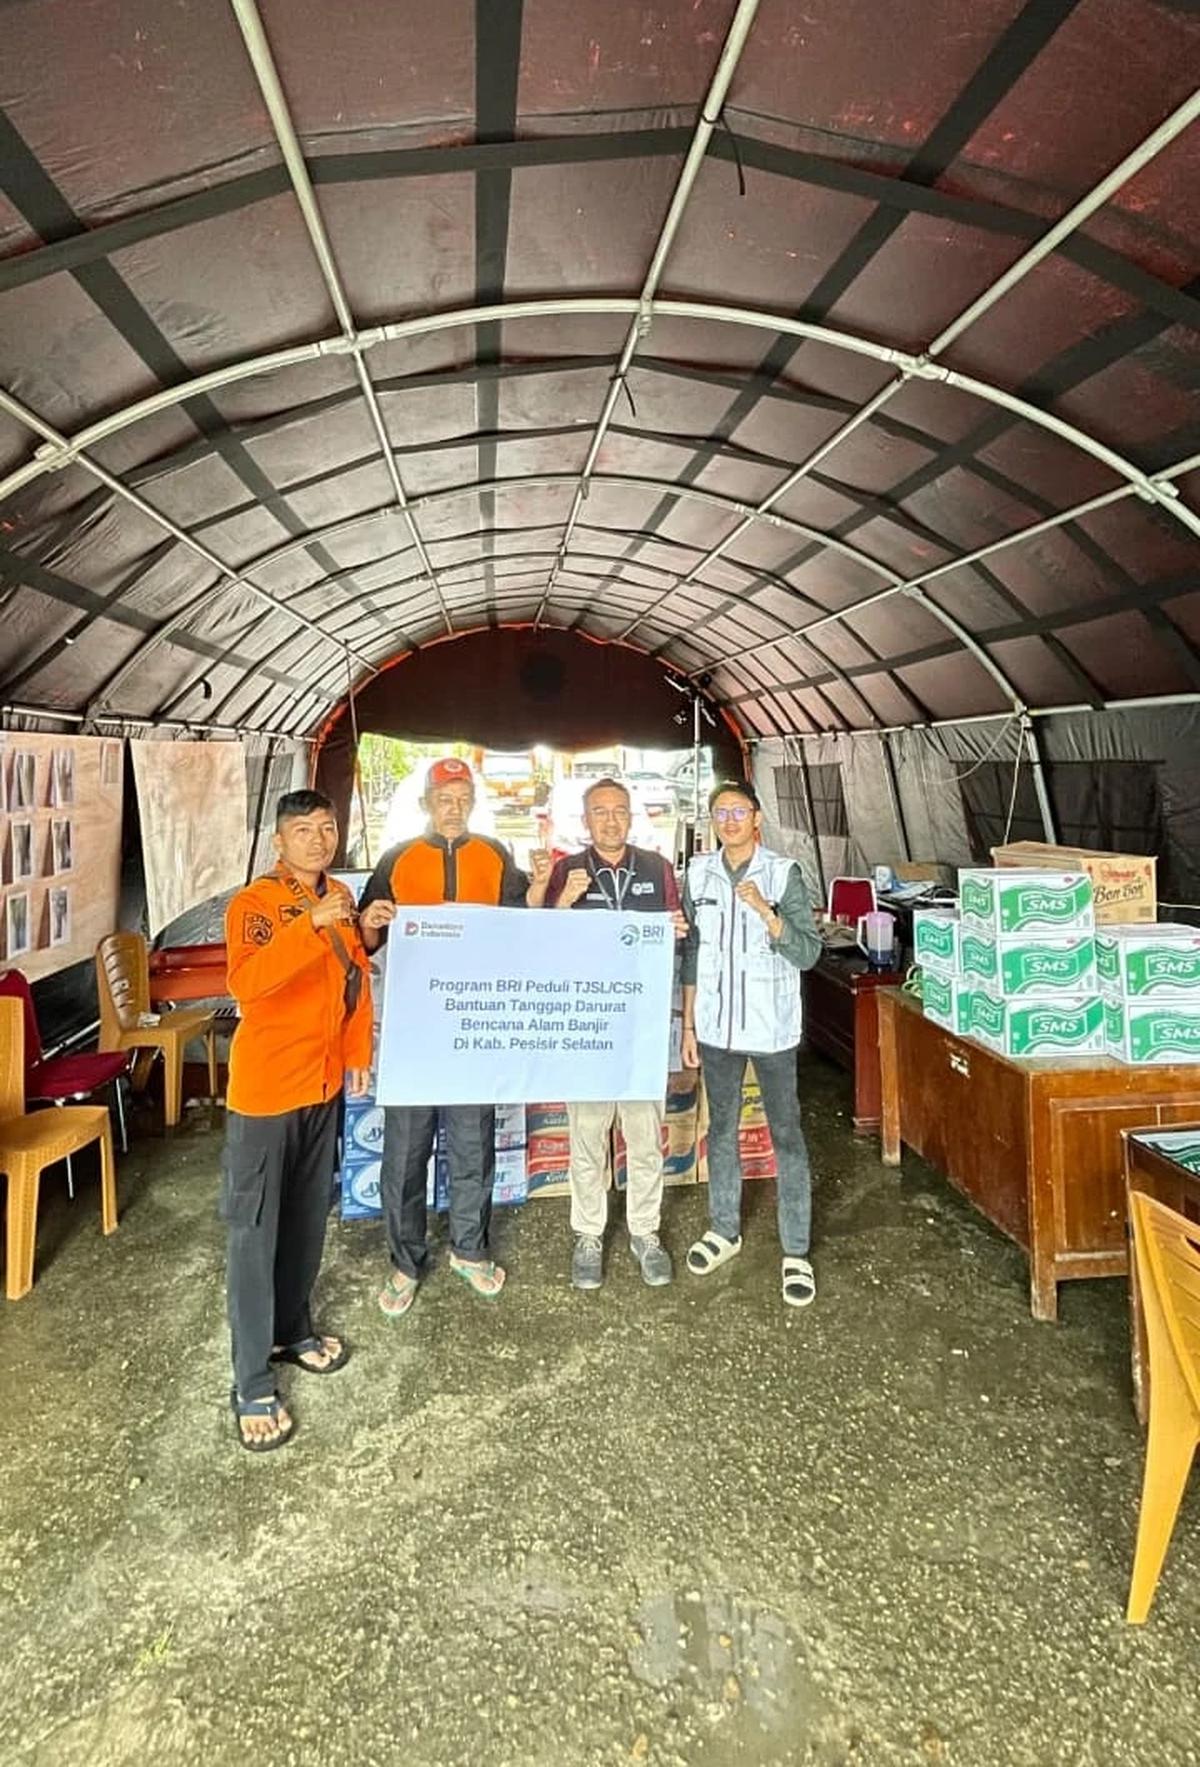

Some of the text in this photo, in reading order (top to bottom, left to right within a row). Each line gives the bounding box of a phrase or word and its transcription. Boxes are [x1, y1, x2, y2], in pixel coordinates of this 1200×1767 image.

[1026, 898, 1068, 911] SMS
[642, 924, 664, 938] BRI
[1029, 960, 1070, 973] SMS
[1153, 960, 1196, 973] SMS
[429, 979, 643, 994] Program BRI Peduli TJSL/CSR
[445, 998, 626, 1015] Bantuan Tanggap Darurat
[461, 1018, 609, 1034] Bencana Alam Banjir
[1036, 1020, 1079, 1033] SMS
[1160, 1027, 1200, 1040] SMS
[454, 1037, 613, 1051] Di Kab. Pesisir Selatan
